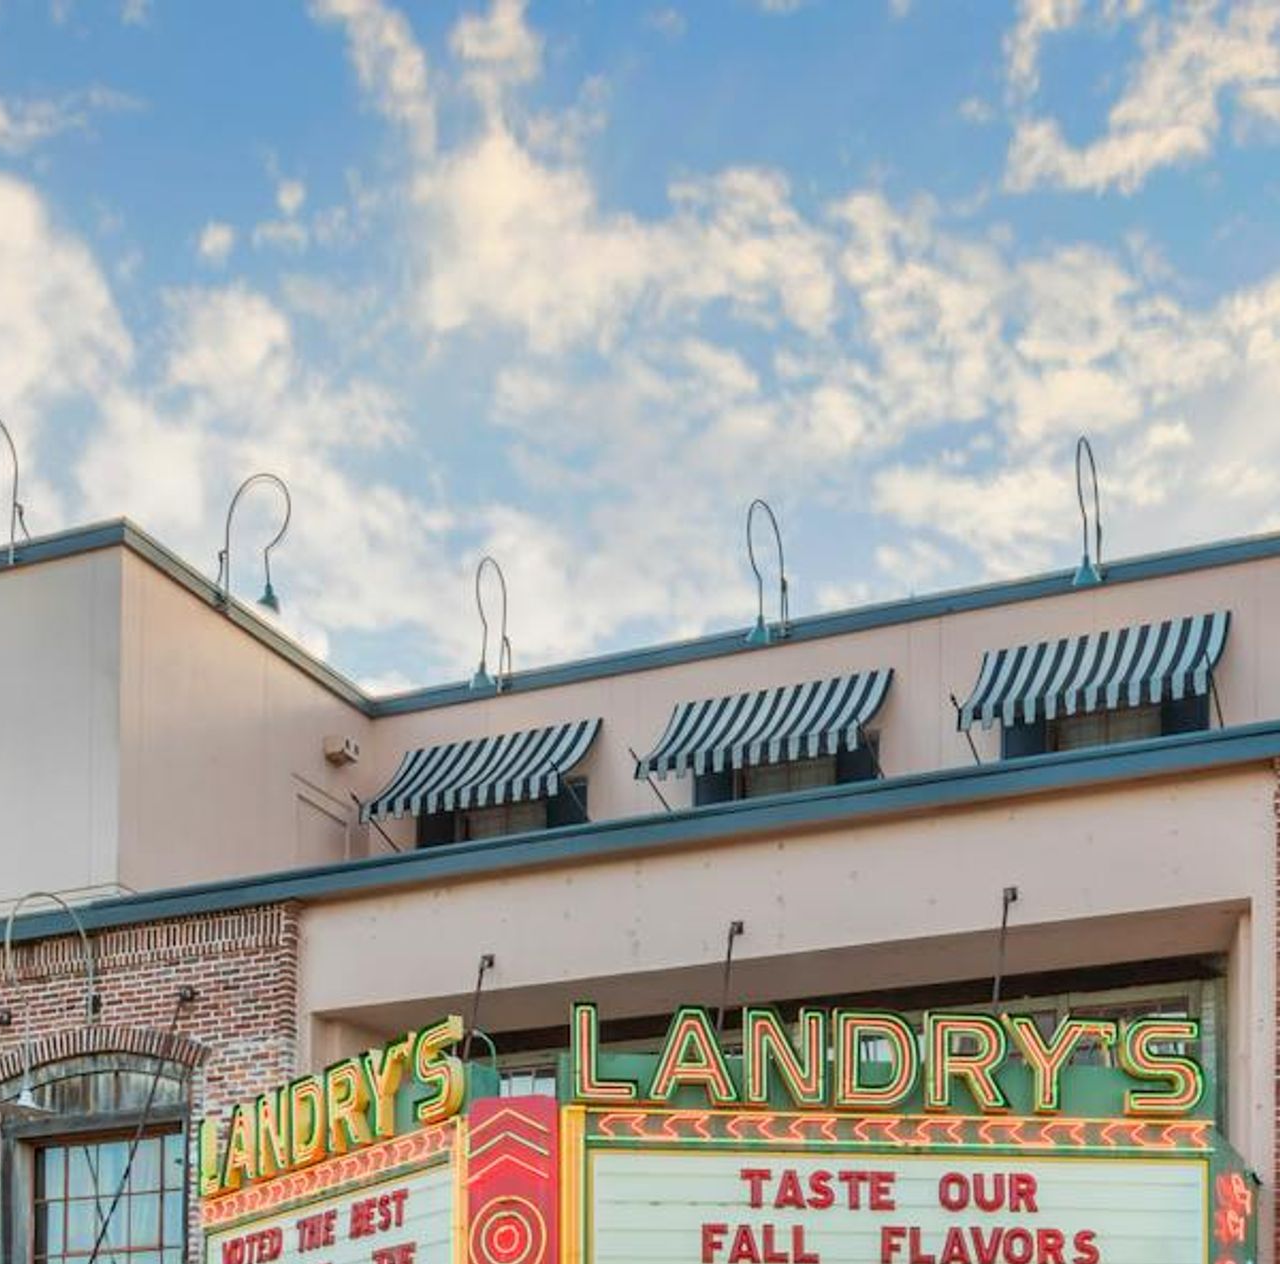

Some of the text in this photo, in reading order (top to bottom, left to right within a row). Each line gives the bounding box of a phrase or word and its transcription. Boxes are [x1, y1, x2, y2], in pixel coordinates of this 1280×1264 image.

[571, 1002, 1208, 1115] LANDRY'S
[199, 1014, 465, 1198] LANDRY'S
[296, 1209, 338, 1253] THE
[349, 1188, 409, 1240] BEST
[739, 1168, 1039, 1213] TASTE OUR
[700, 1224, 820, 1264] FALL
